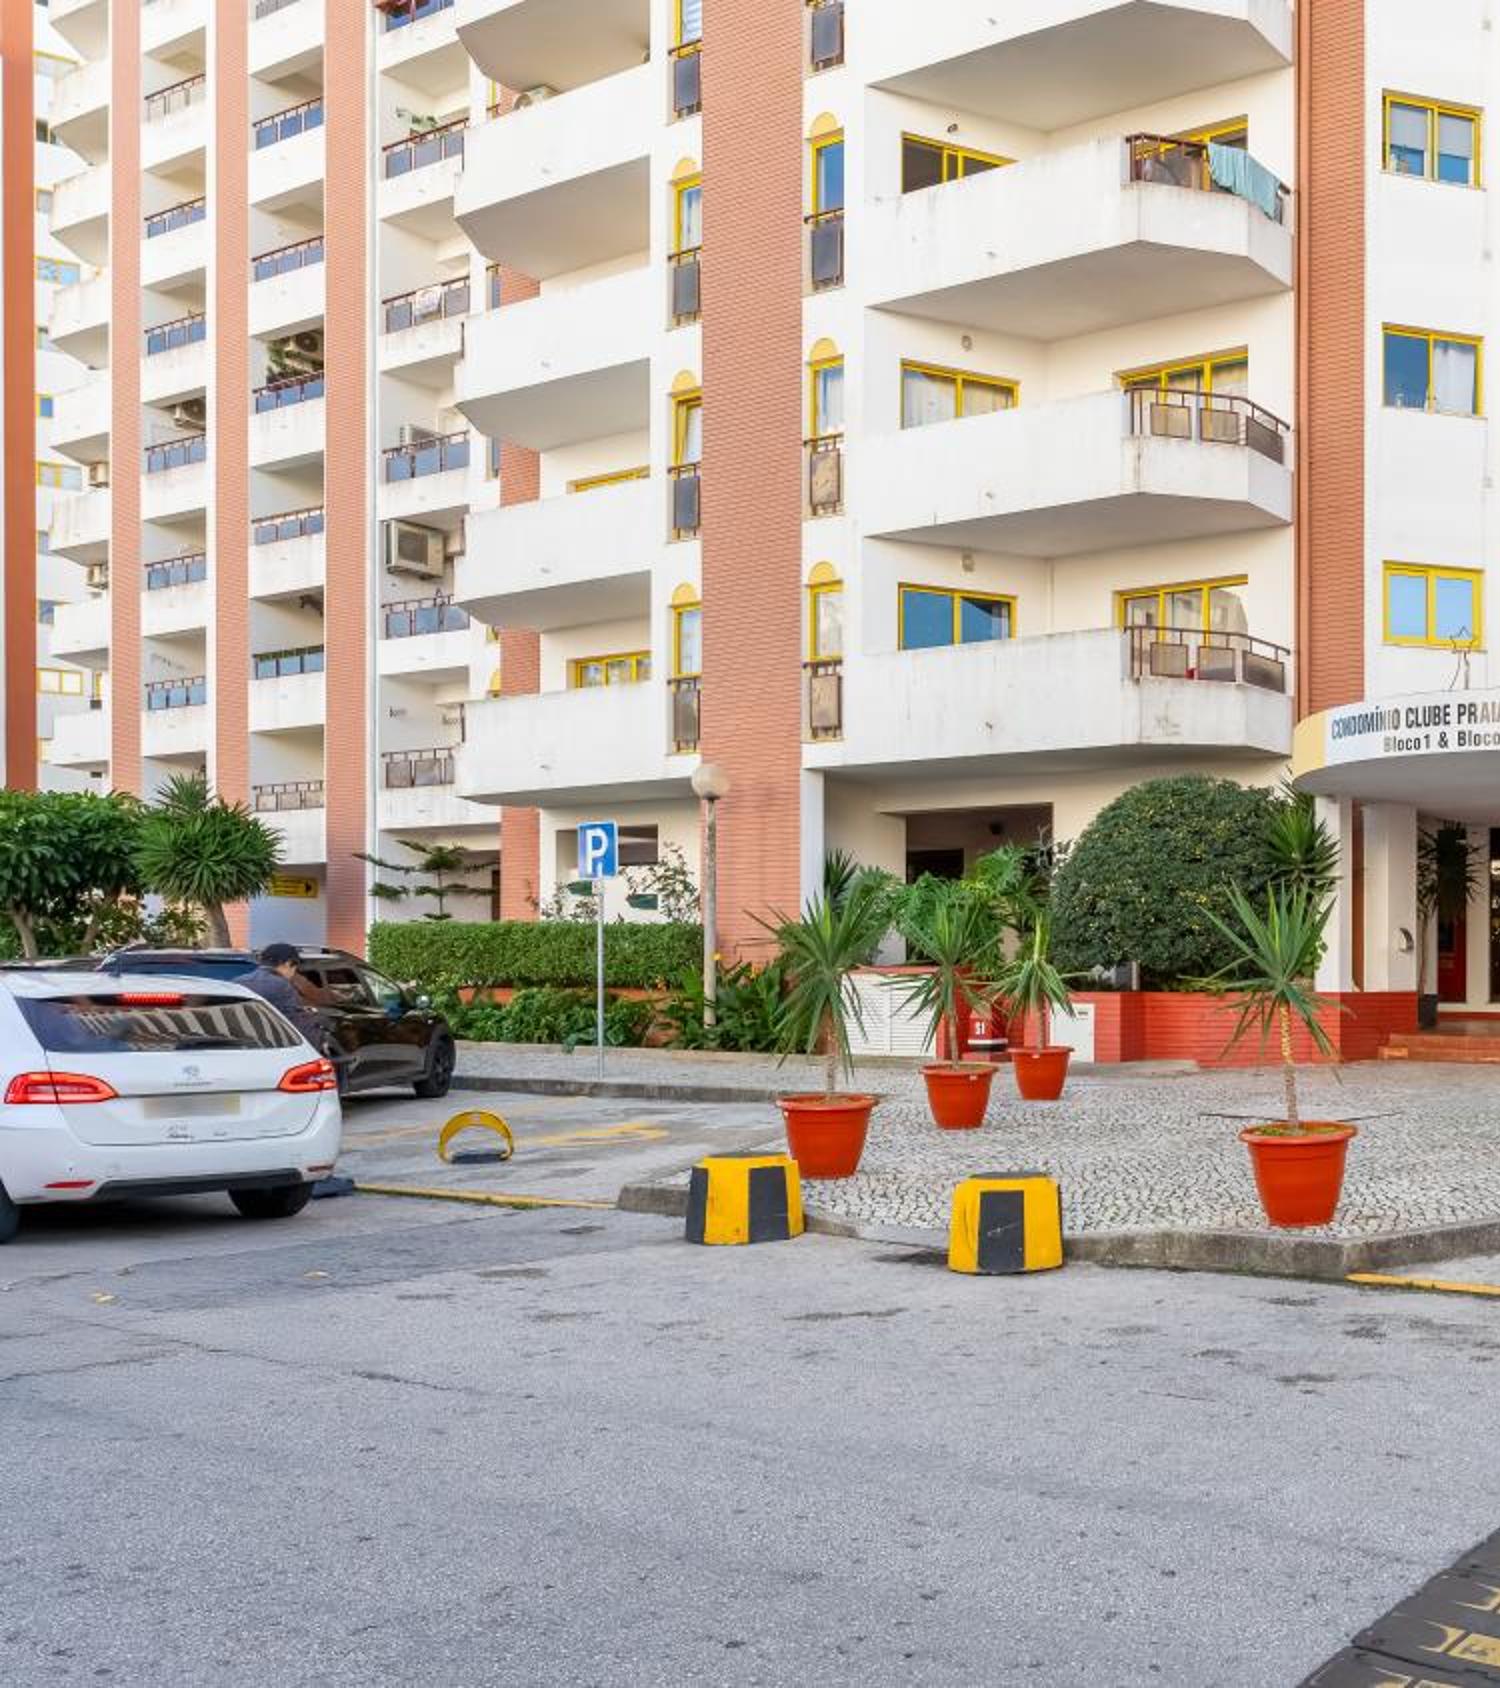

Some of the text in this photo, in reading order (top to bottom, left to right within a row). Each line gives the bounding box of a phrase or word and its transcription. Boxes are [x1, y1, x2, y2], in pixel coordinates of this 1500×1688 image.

[1331, 706, 1400, 739] CONDOMÍNIO
[1406, 704, 1451, 729] CLUBE
[1438, 731, 1449, 749] &
[585, 827, 609, 875] P
